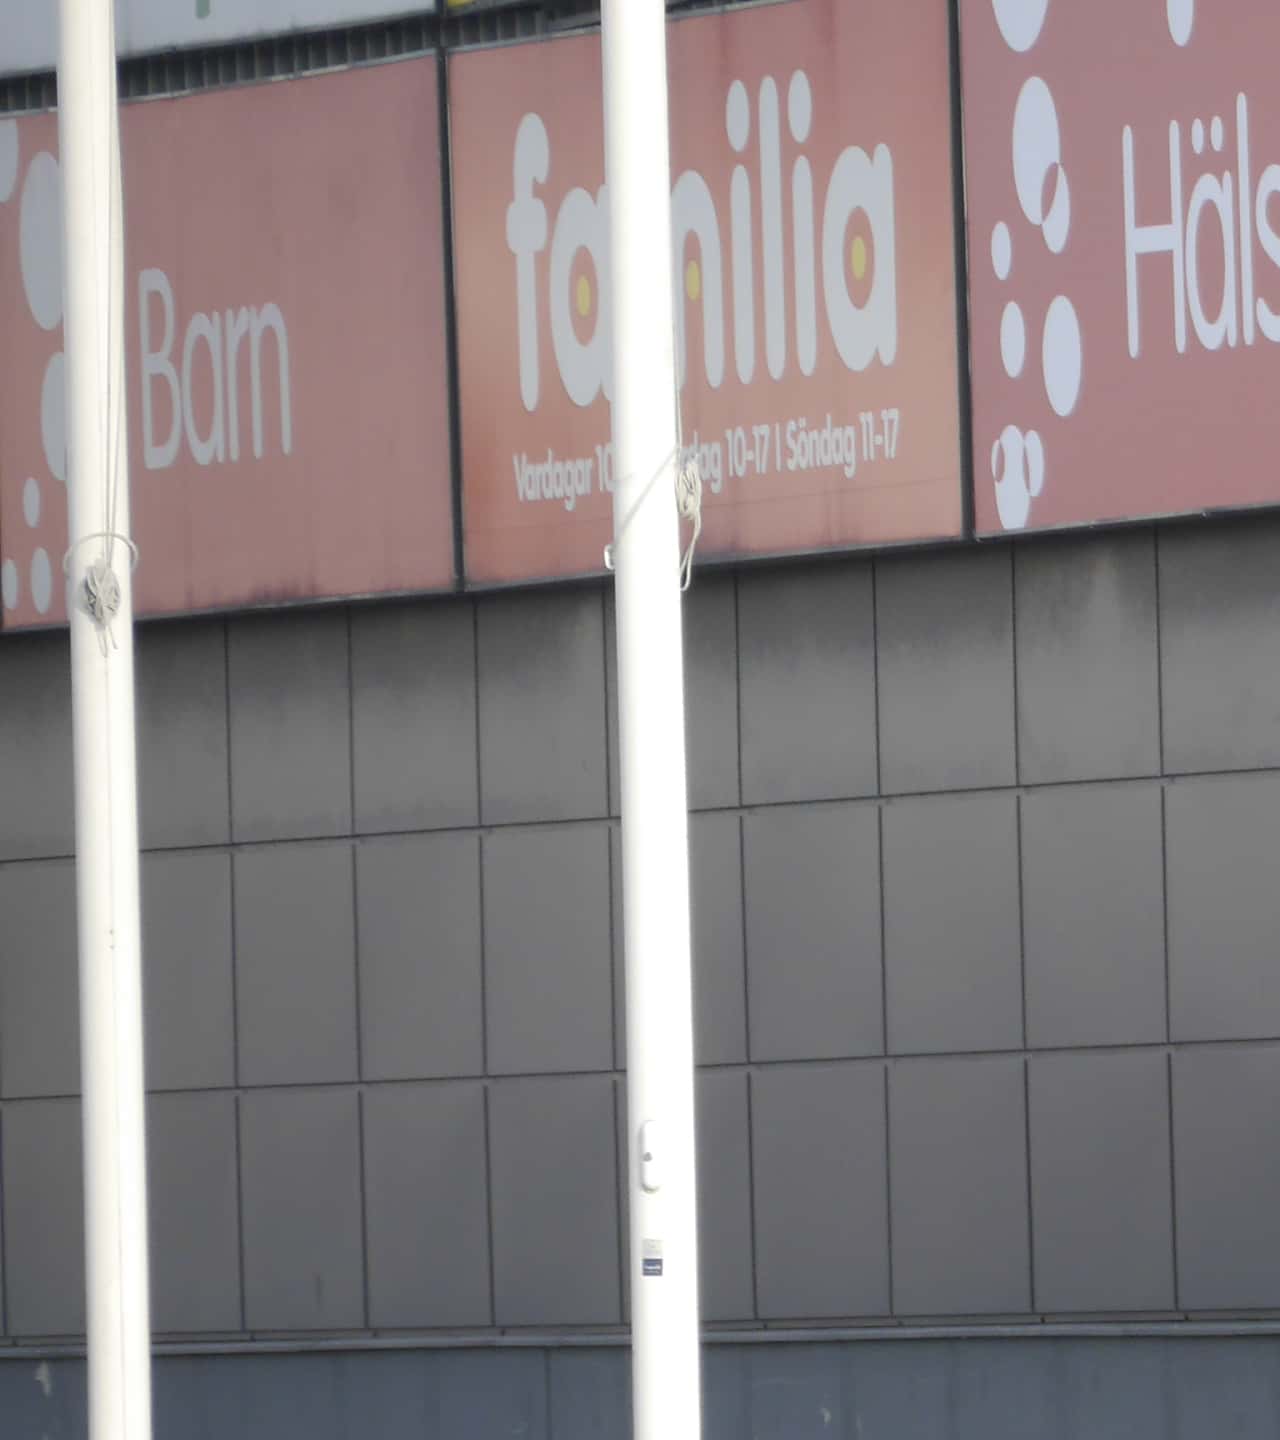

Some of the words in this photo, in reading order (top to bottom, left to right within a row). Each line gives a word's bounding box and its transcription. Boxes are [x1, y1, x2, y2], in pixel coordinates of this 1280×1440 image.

[138, 267, 292, 470] Barn
[513, 448, 593, 511] Vardagar
[726, 423, 770, 478] 10-17
[786, 414, 856, 479] Söndag
[859, 408, 899, 460] 11-17
